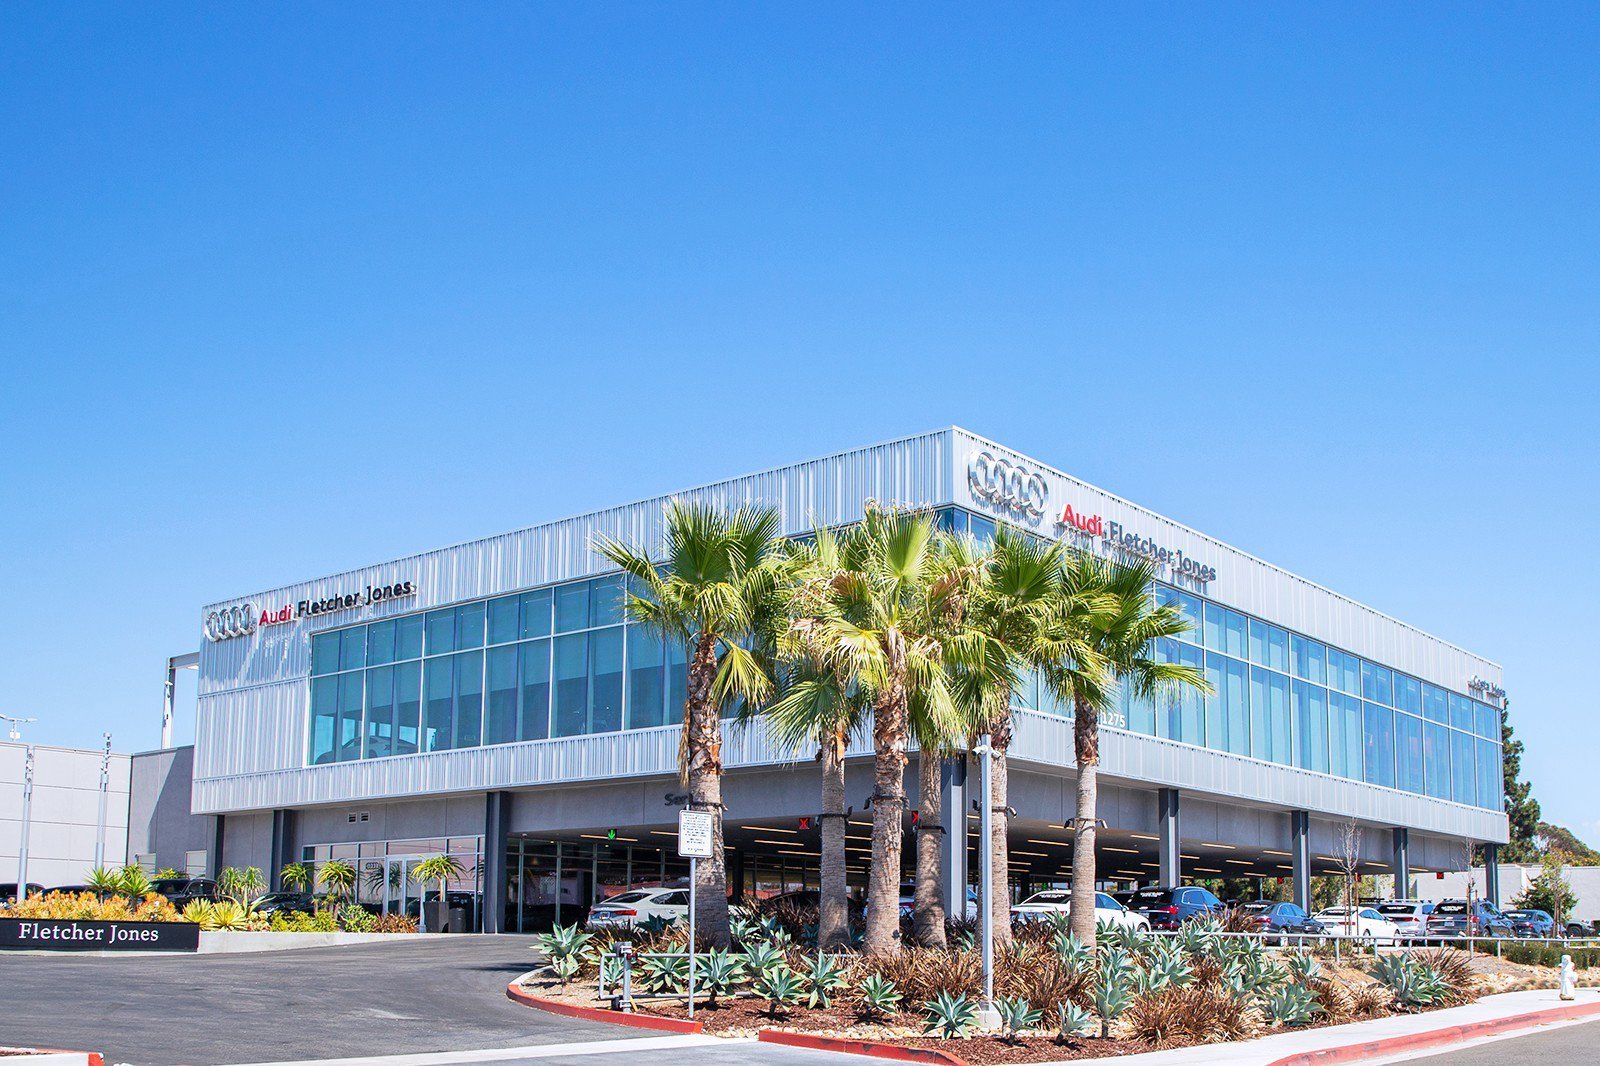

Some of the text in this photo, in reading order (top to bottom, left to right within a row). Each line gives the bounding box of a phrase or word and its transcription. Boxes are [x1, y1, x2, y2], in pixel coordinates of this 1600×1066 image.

[1062, 503, 1217, 582] Audi Fletcher Jones
[258, 580, 412, 626] Audi Fletcher Jones
[1102, 711, 1126, 728] 1275
[18, 922, 159, 944] Fletcher Jones
